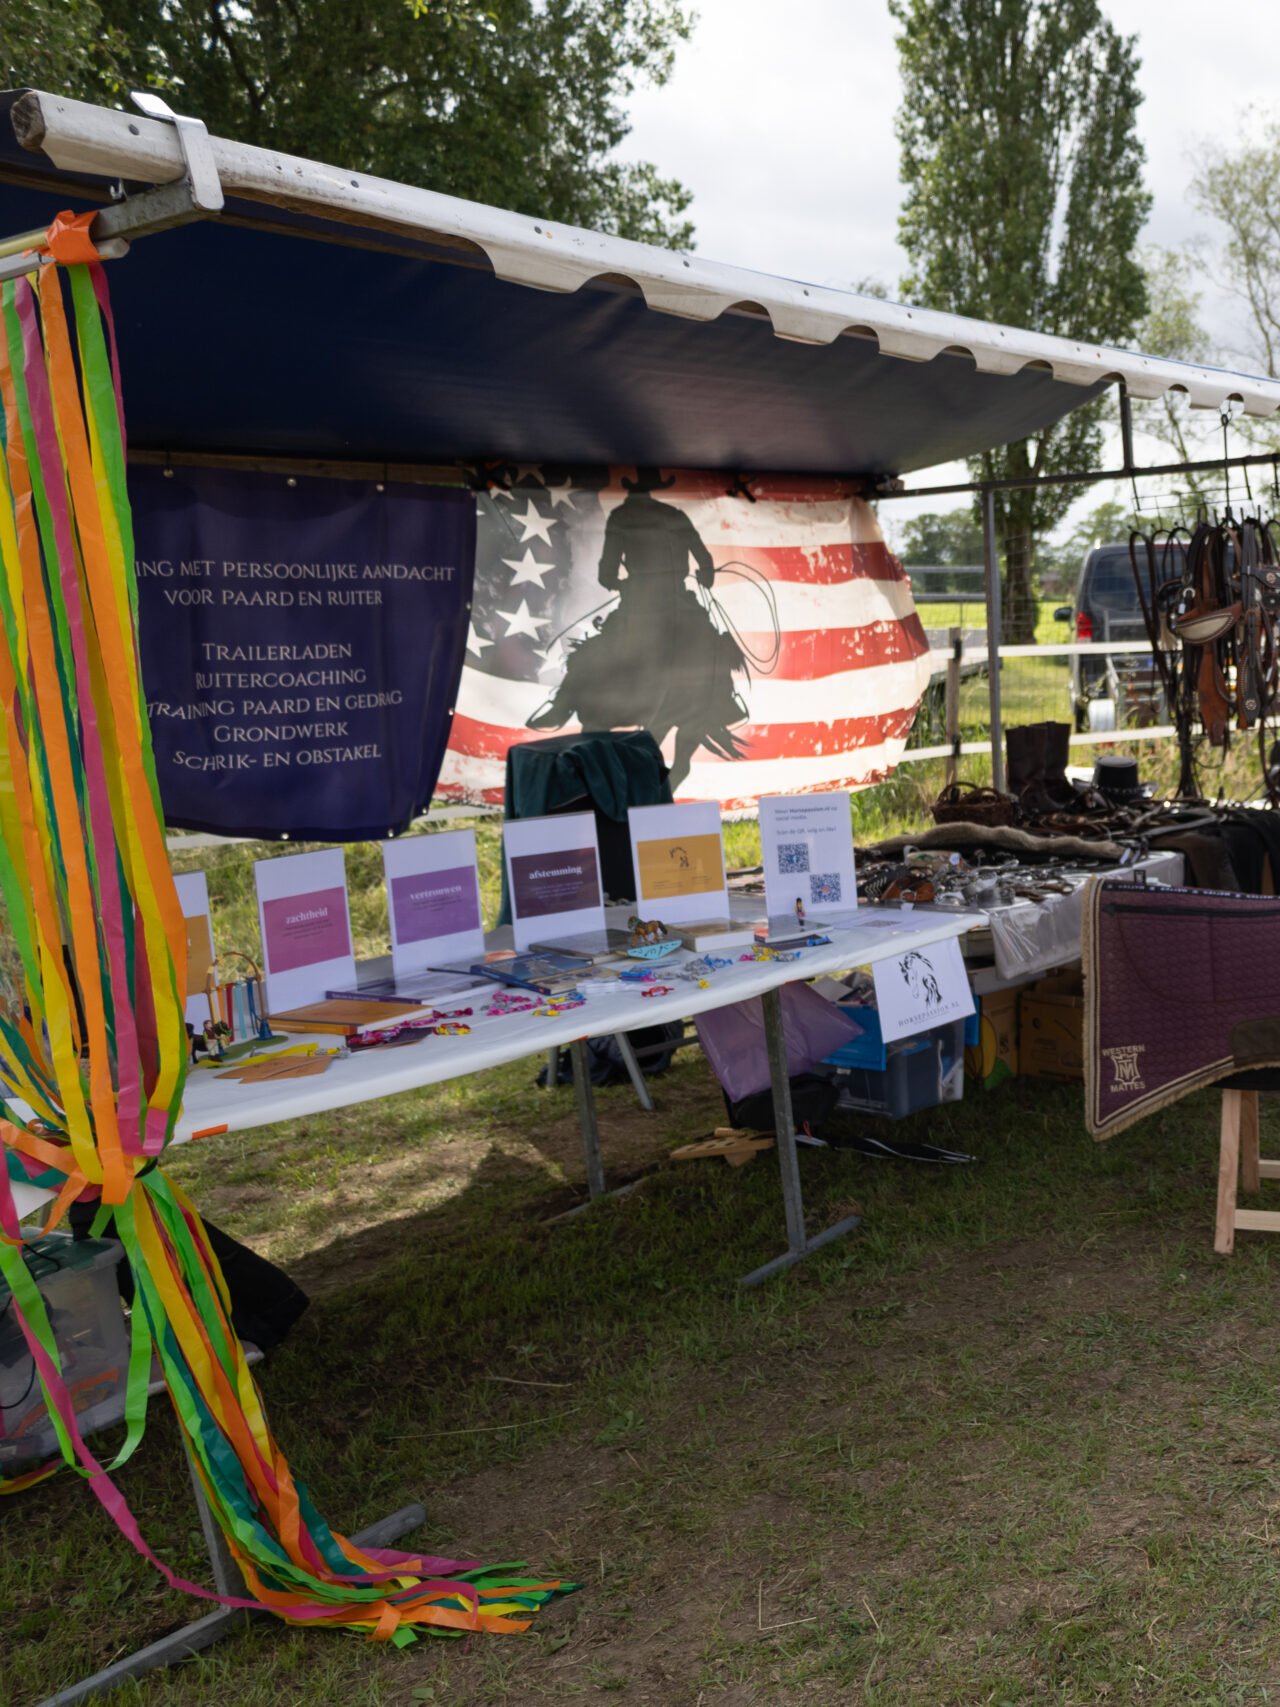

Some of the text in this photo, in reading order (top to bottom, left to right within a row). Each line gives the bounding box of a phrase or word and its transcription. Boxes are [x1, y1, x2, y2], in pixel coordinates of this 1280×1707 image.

[180, 560, 216, 577] MET
[222, 561, 358, 582] PERSOONLIJKE
[362, 564, 455, 581] AANDACHT
[163, 588, 383, 607] VOOR PAARD EN RUITER
[202, 643, 352, 661] TRAILERLADEN
[195, 668, 367, 690] RUITERCOACHING
[243, 698, 311, 716] PAARD
[315, 696, 340, 712] EN
[344, 690, 403, 710] GEDRAG
[213, 721, 349, 743] GRONDWERK
[172, 743, 382, 771] SCHRIK- EN OBSTAKEL
[528, 864, 583, 881] afstemming
[410, 885, 462, 900] vertrouwen
[286, 907, 328, 924] zachtheid
[1101, 1044, 1146, 1057] WESTERN
[1110, 1081, 1146, 1094] MATTES
